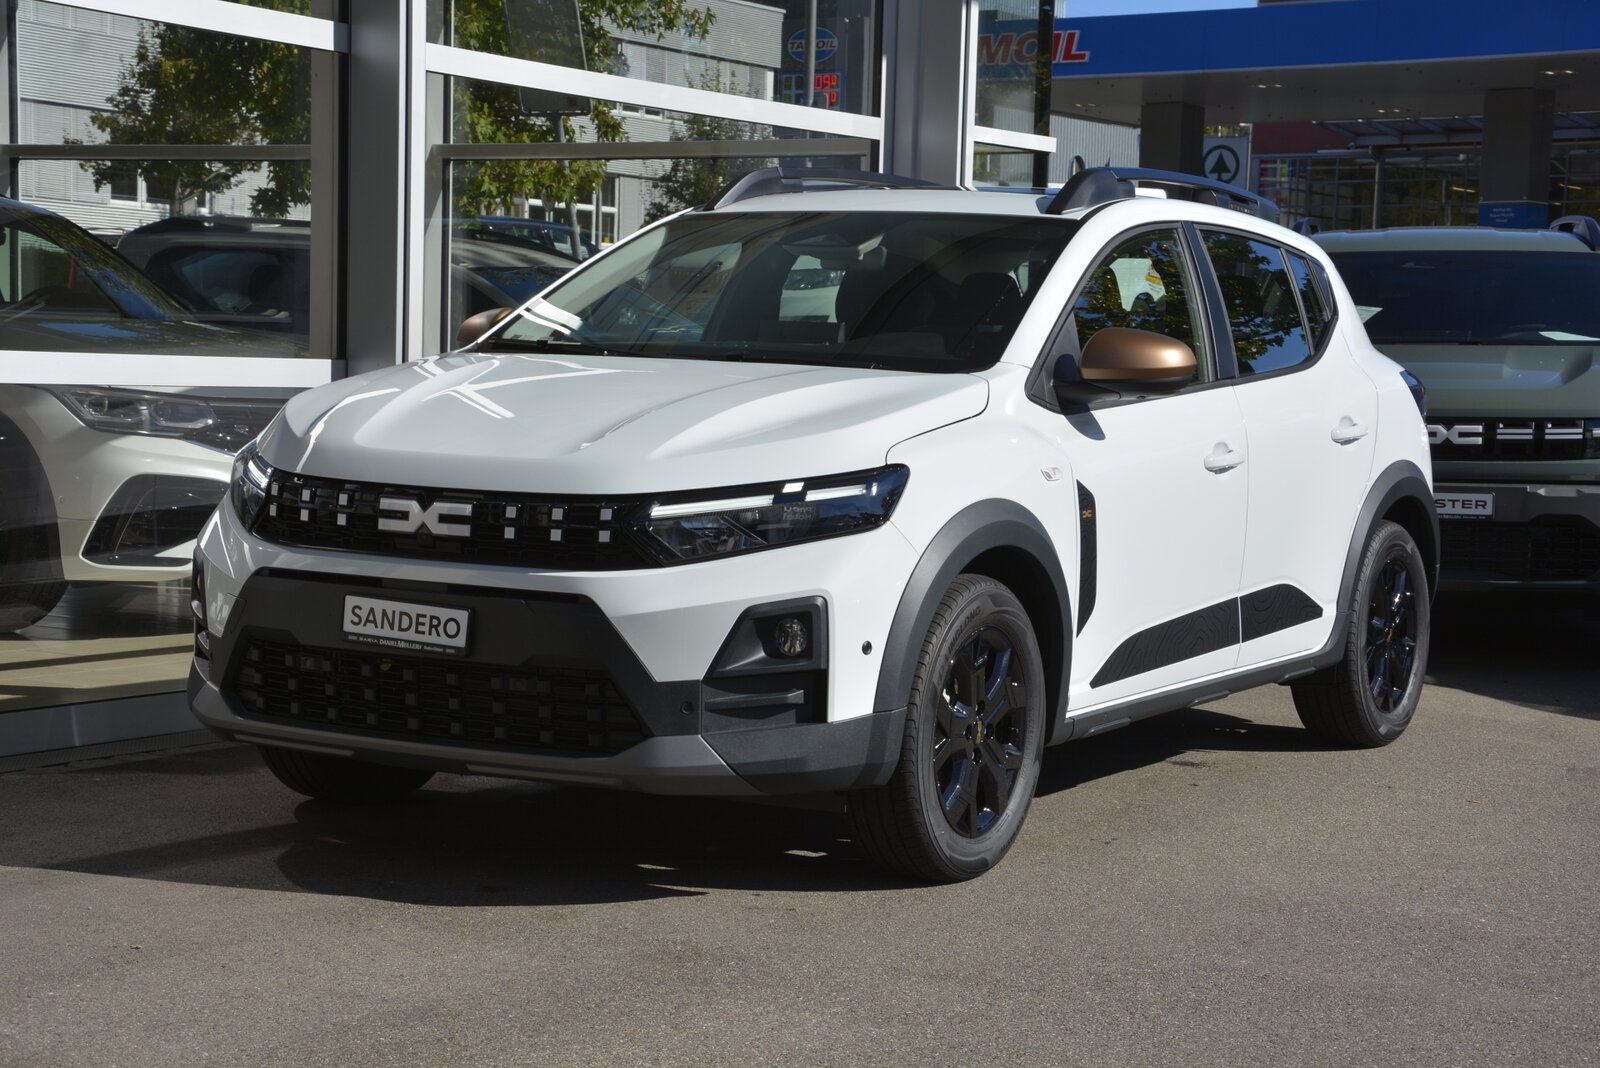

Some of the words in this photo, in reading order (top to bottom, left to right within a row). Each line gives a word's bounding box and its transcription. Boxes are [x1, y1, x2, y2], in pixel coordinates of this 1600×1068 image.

[790, 40, 836, 50] TAOIL
[978, 29, 1091, 65] MOIL
[1434, 498, 1487, 510] STER
[350, 604, 461, 639] SANDERO
